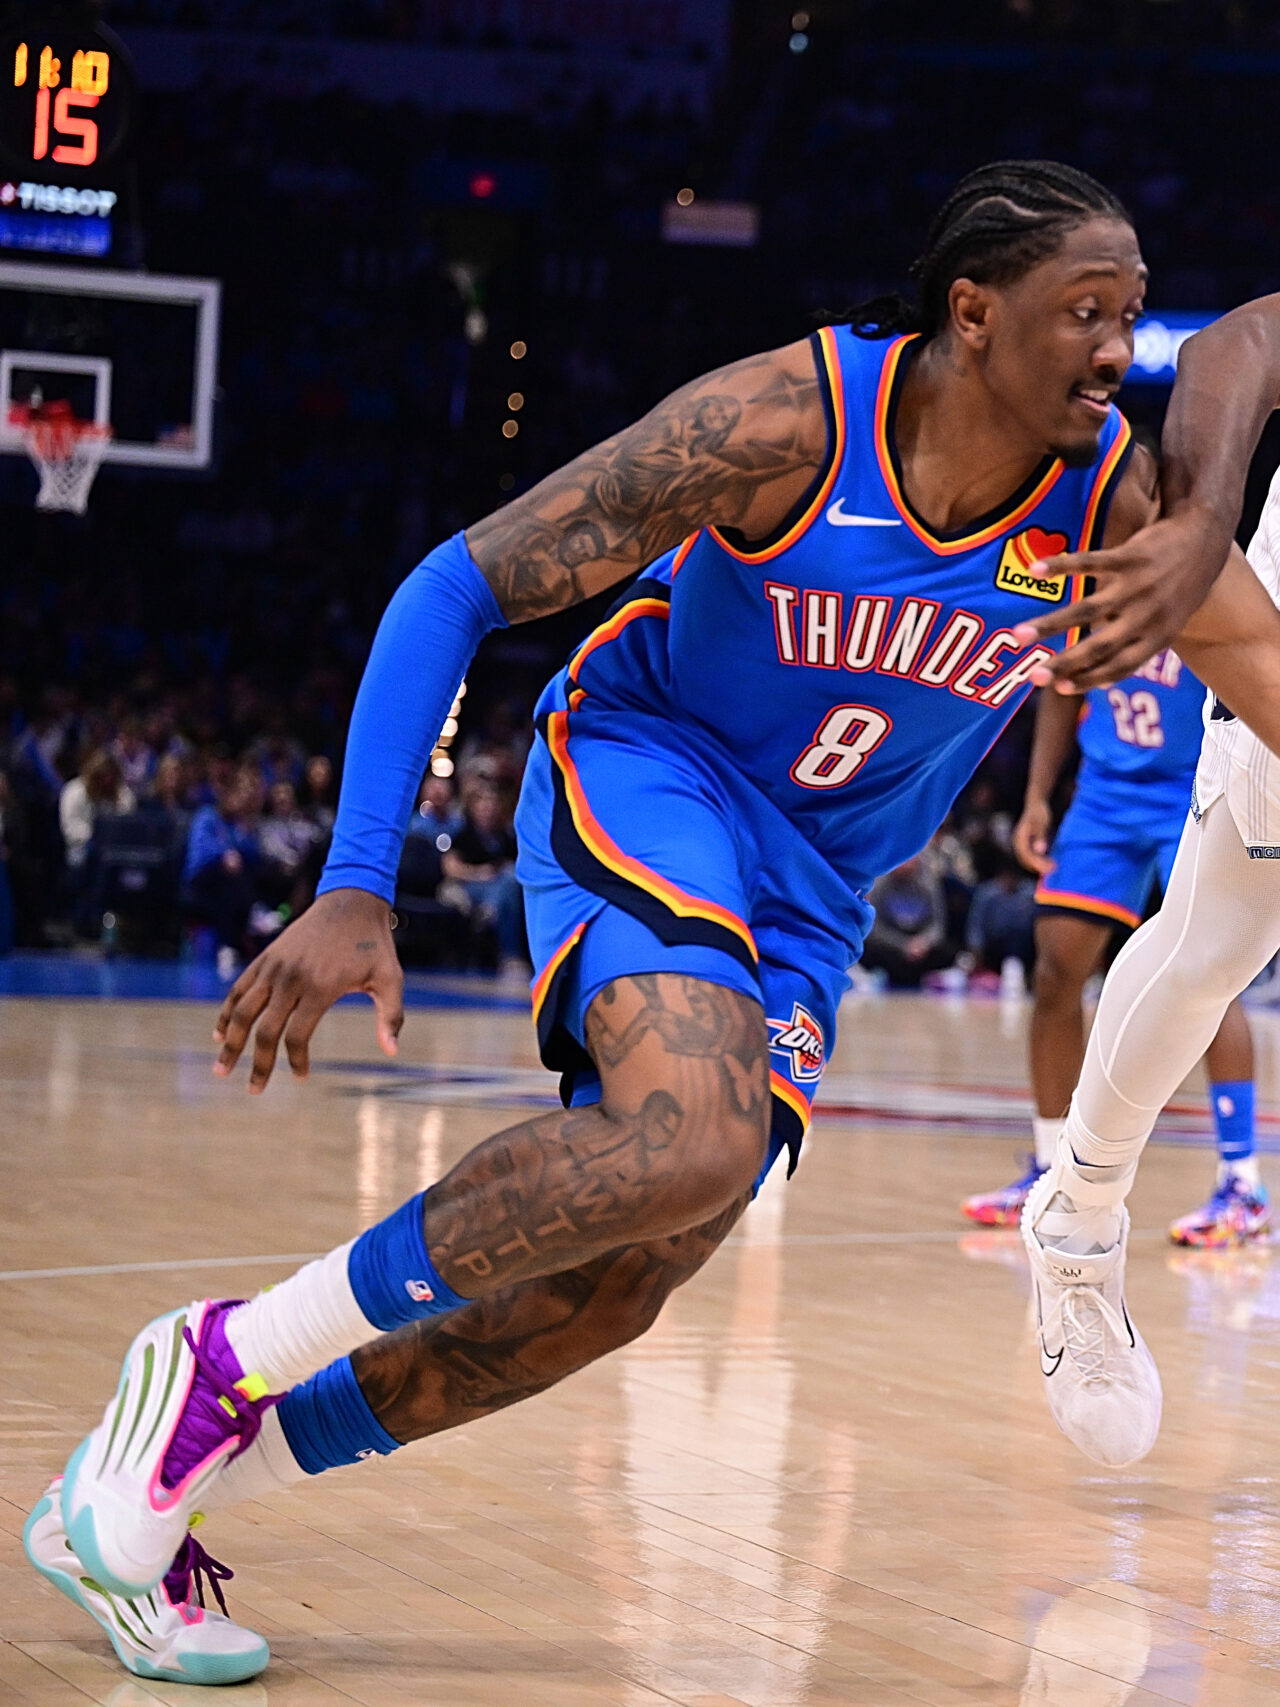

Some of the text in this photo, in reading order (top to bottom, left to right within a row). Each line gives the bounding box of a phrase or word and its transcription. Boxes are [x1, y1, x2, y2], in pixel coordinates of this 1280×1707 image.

[33, 87, 100, 166] 15
[764, 581, 1057, 709] THUNDER
[788, 703, 893, 790] 8
[1107, 687, 1165, 748] 22
